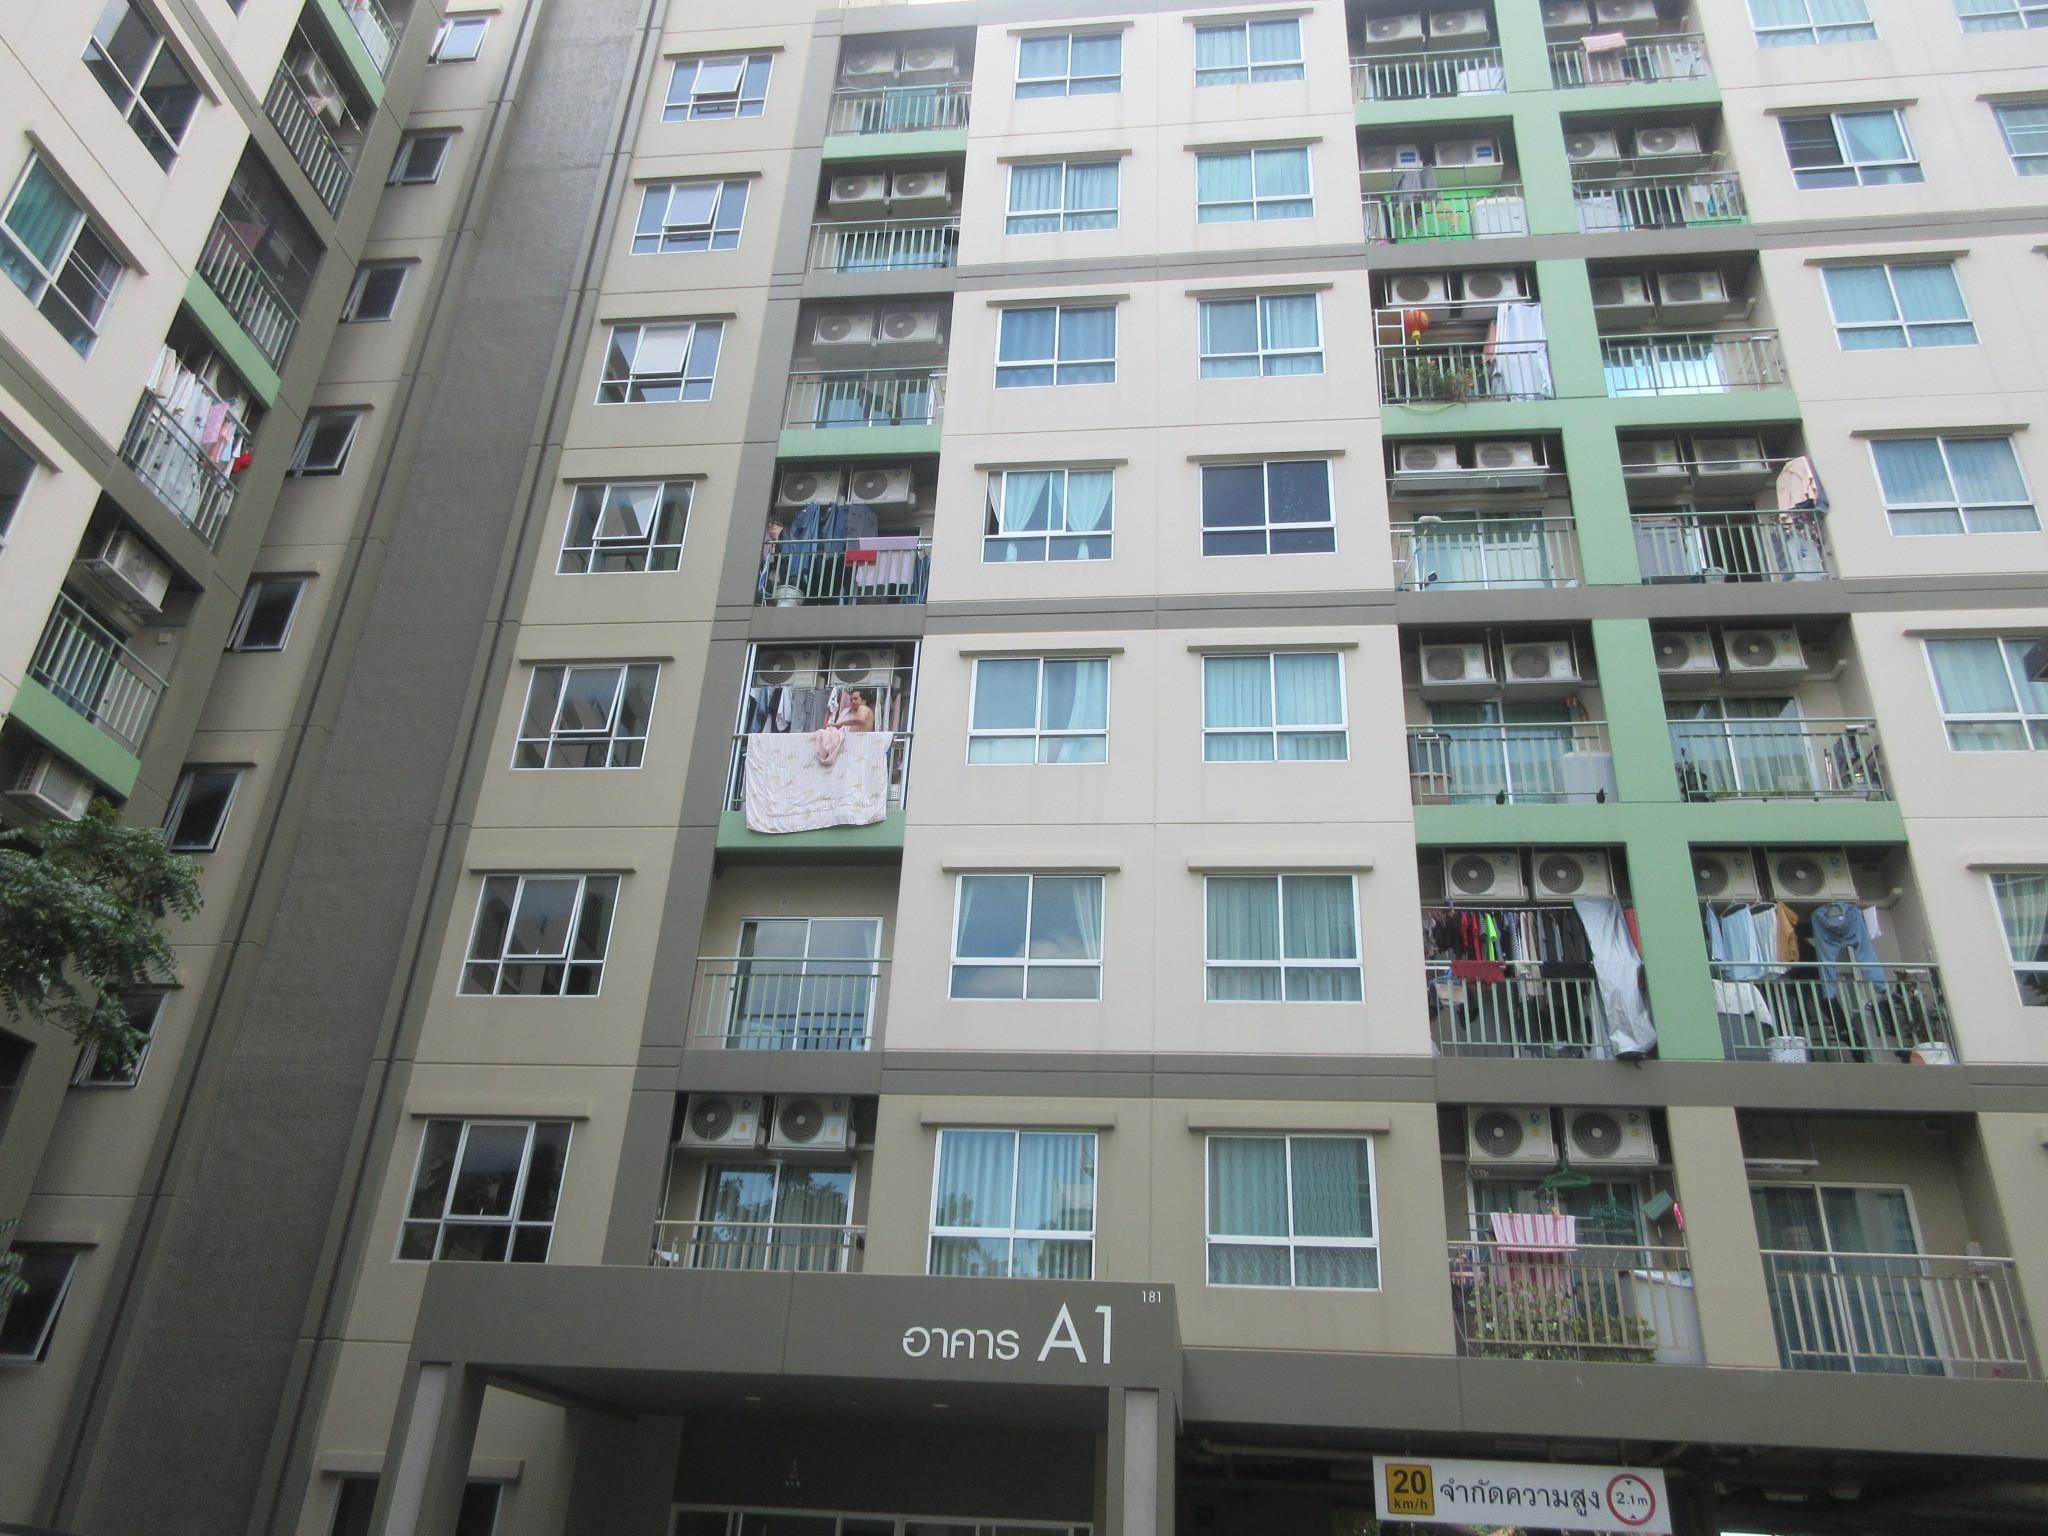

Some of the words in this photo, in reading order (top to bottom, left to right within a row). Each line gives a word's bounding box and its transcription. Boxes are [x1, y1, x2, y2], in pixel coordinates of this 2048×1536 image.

[1141, 1290, 1162, 1304] 181
[902, 1326, 1020, 1361] อาคาร
[1036, 1301, 1112, 1365] A1
[1393, 1469, 1427, 1495] 20
[1394, 1497, 1428, 1510] km/h
[1440, 1478, 1600, 1517] จำกัดความสูง
